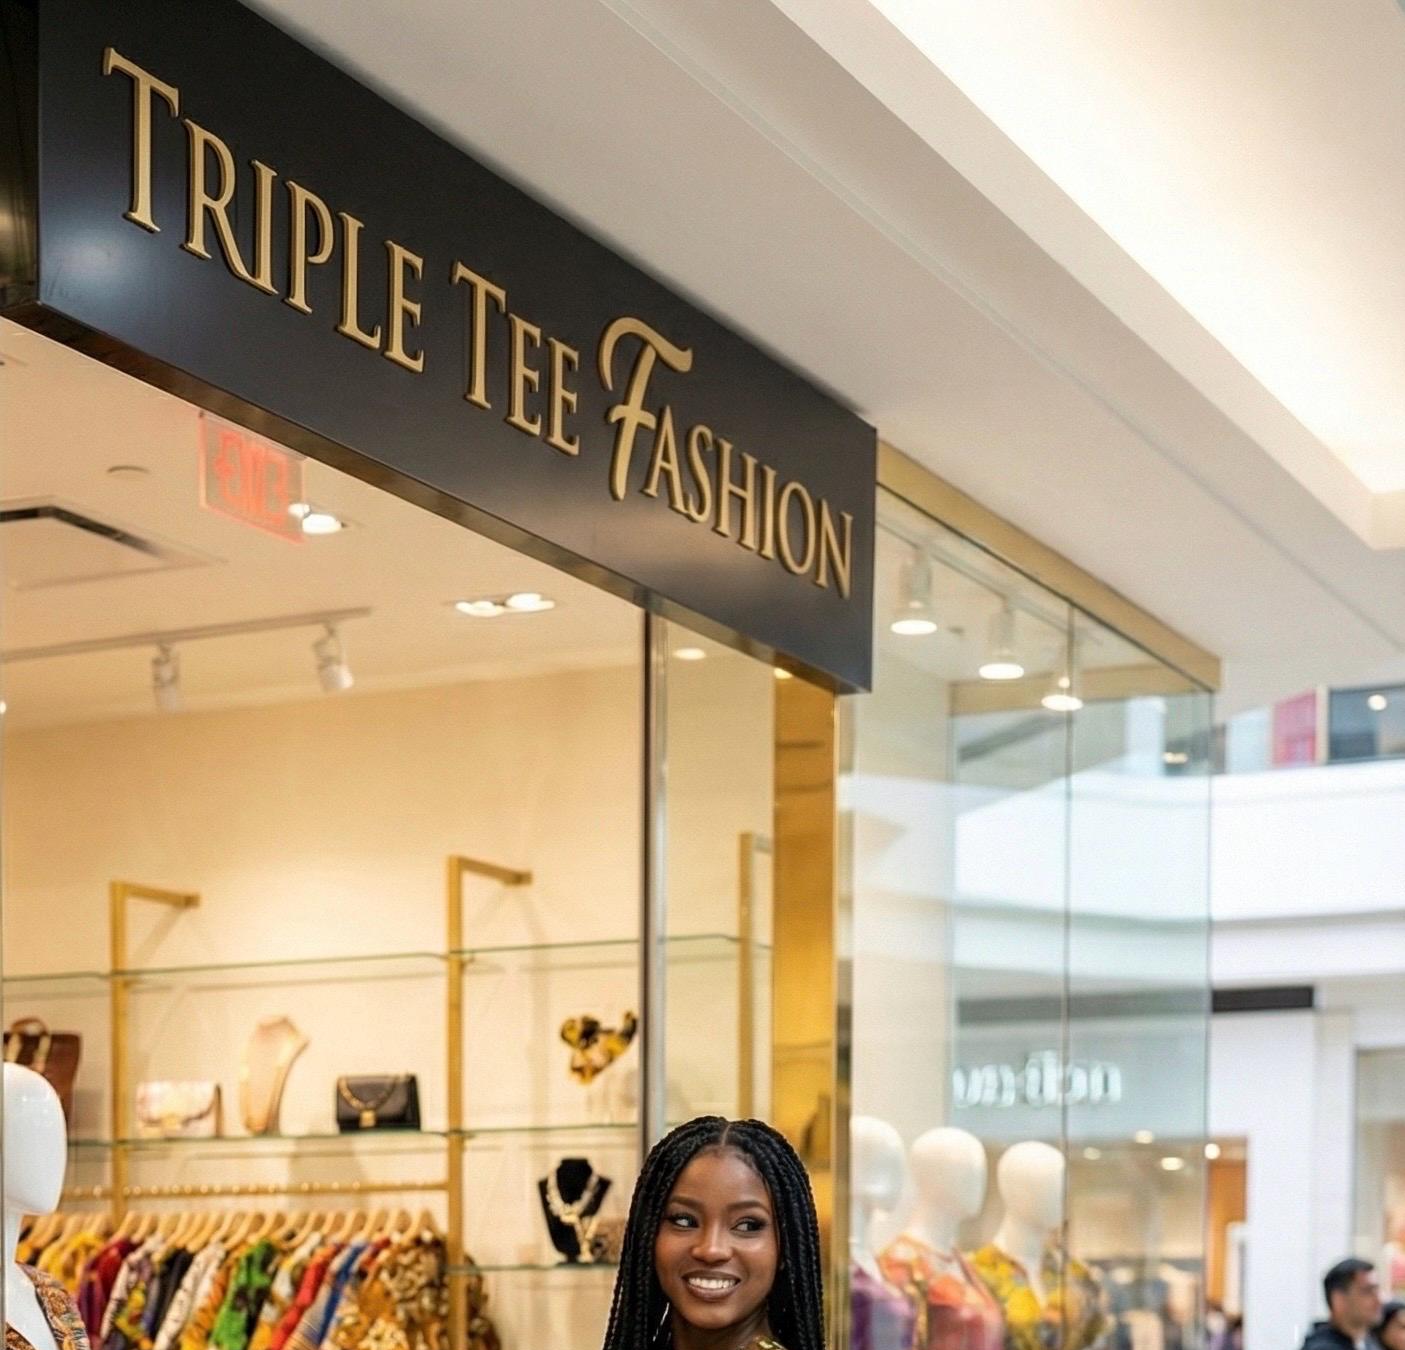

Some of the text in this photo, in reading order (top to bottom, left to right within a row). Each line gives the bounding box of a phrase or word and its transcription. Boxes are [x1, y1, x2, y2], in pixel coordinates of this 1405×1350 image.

[103, 48, 854, 599] TRIPLE TEE FASHION
